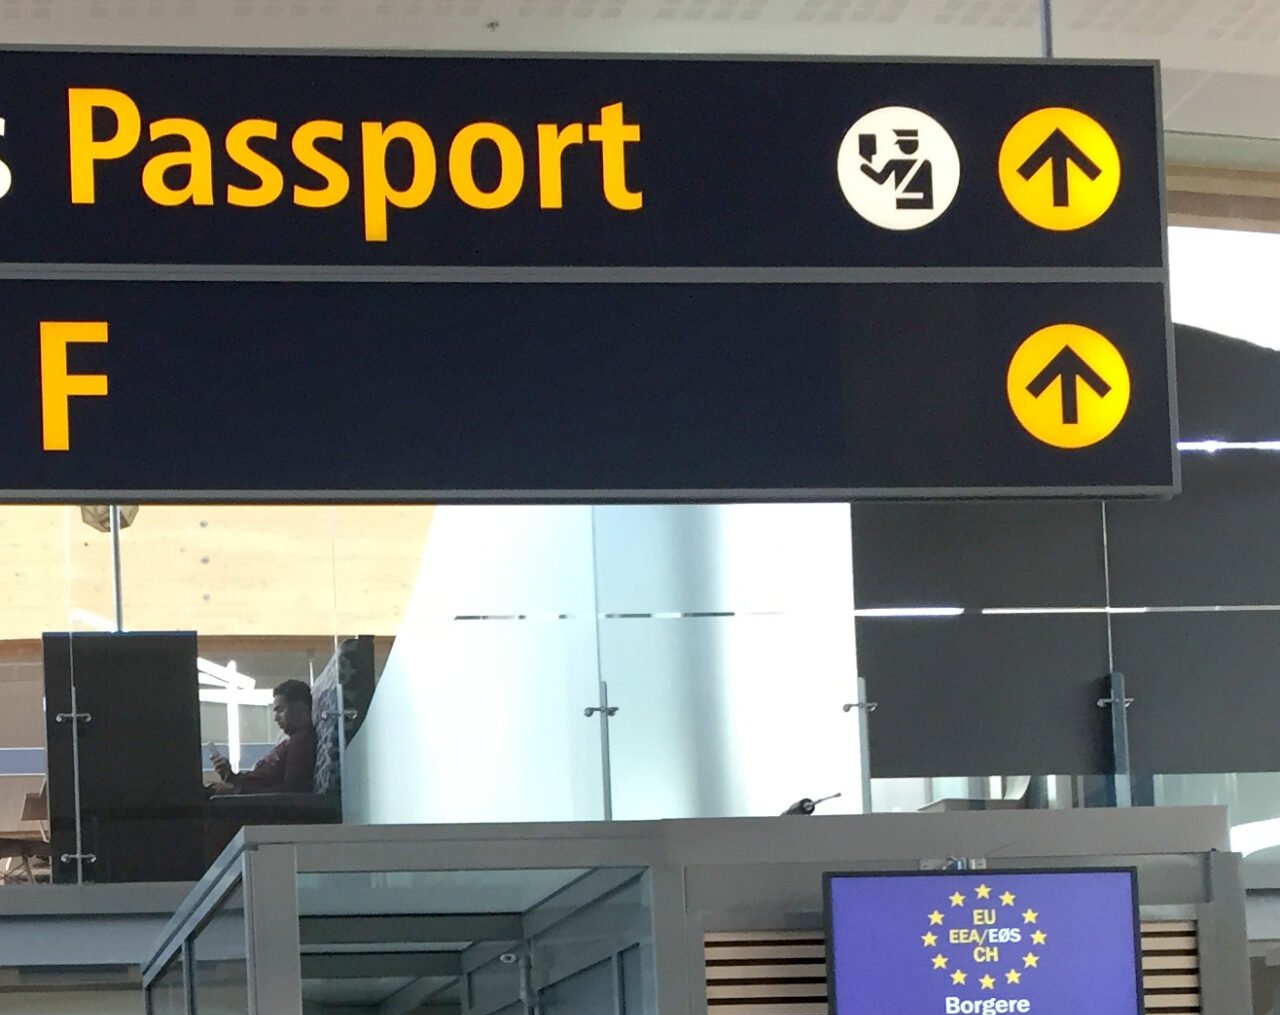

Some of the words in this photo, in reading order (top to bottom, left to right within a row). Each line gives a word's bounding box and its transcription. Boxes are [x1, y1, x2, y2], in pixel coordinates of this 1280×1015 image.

[67, 87, 643, 242] Passport
[39, 321, 109, 451] F
[973, 909, 996, 925] EU
[949, 928, 1021, 945] EEA/EØS
[973, 947, 999, 962] CH
